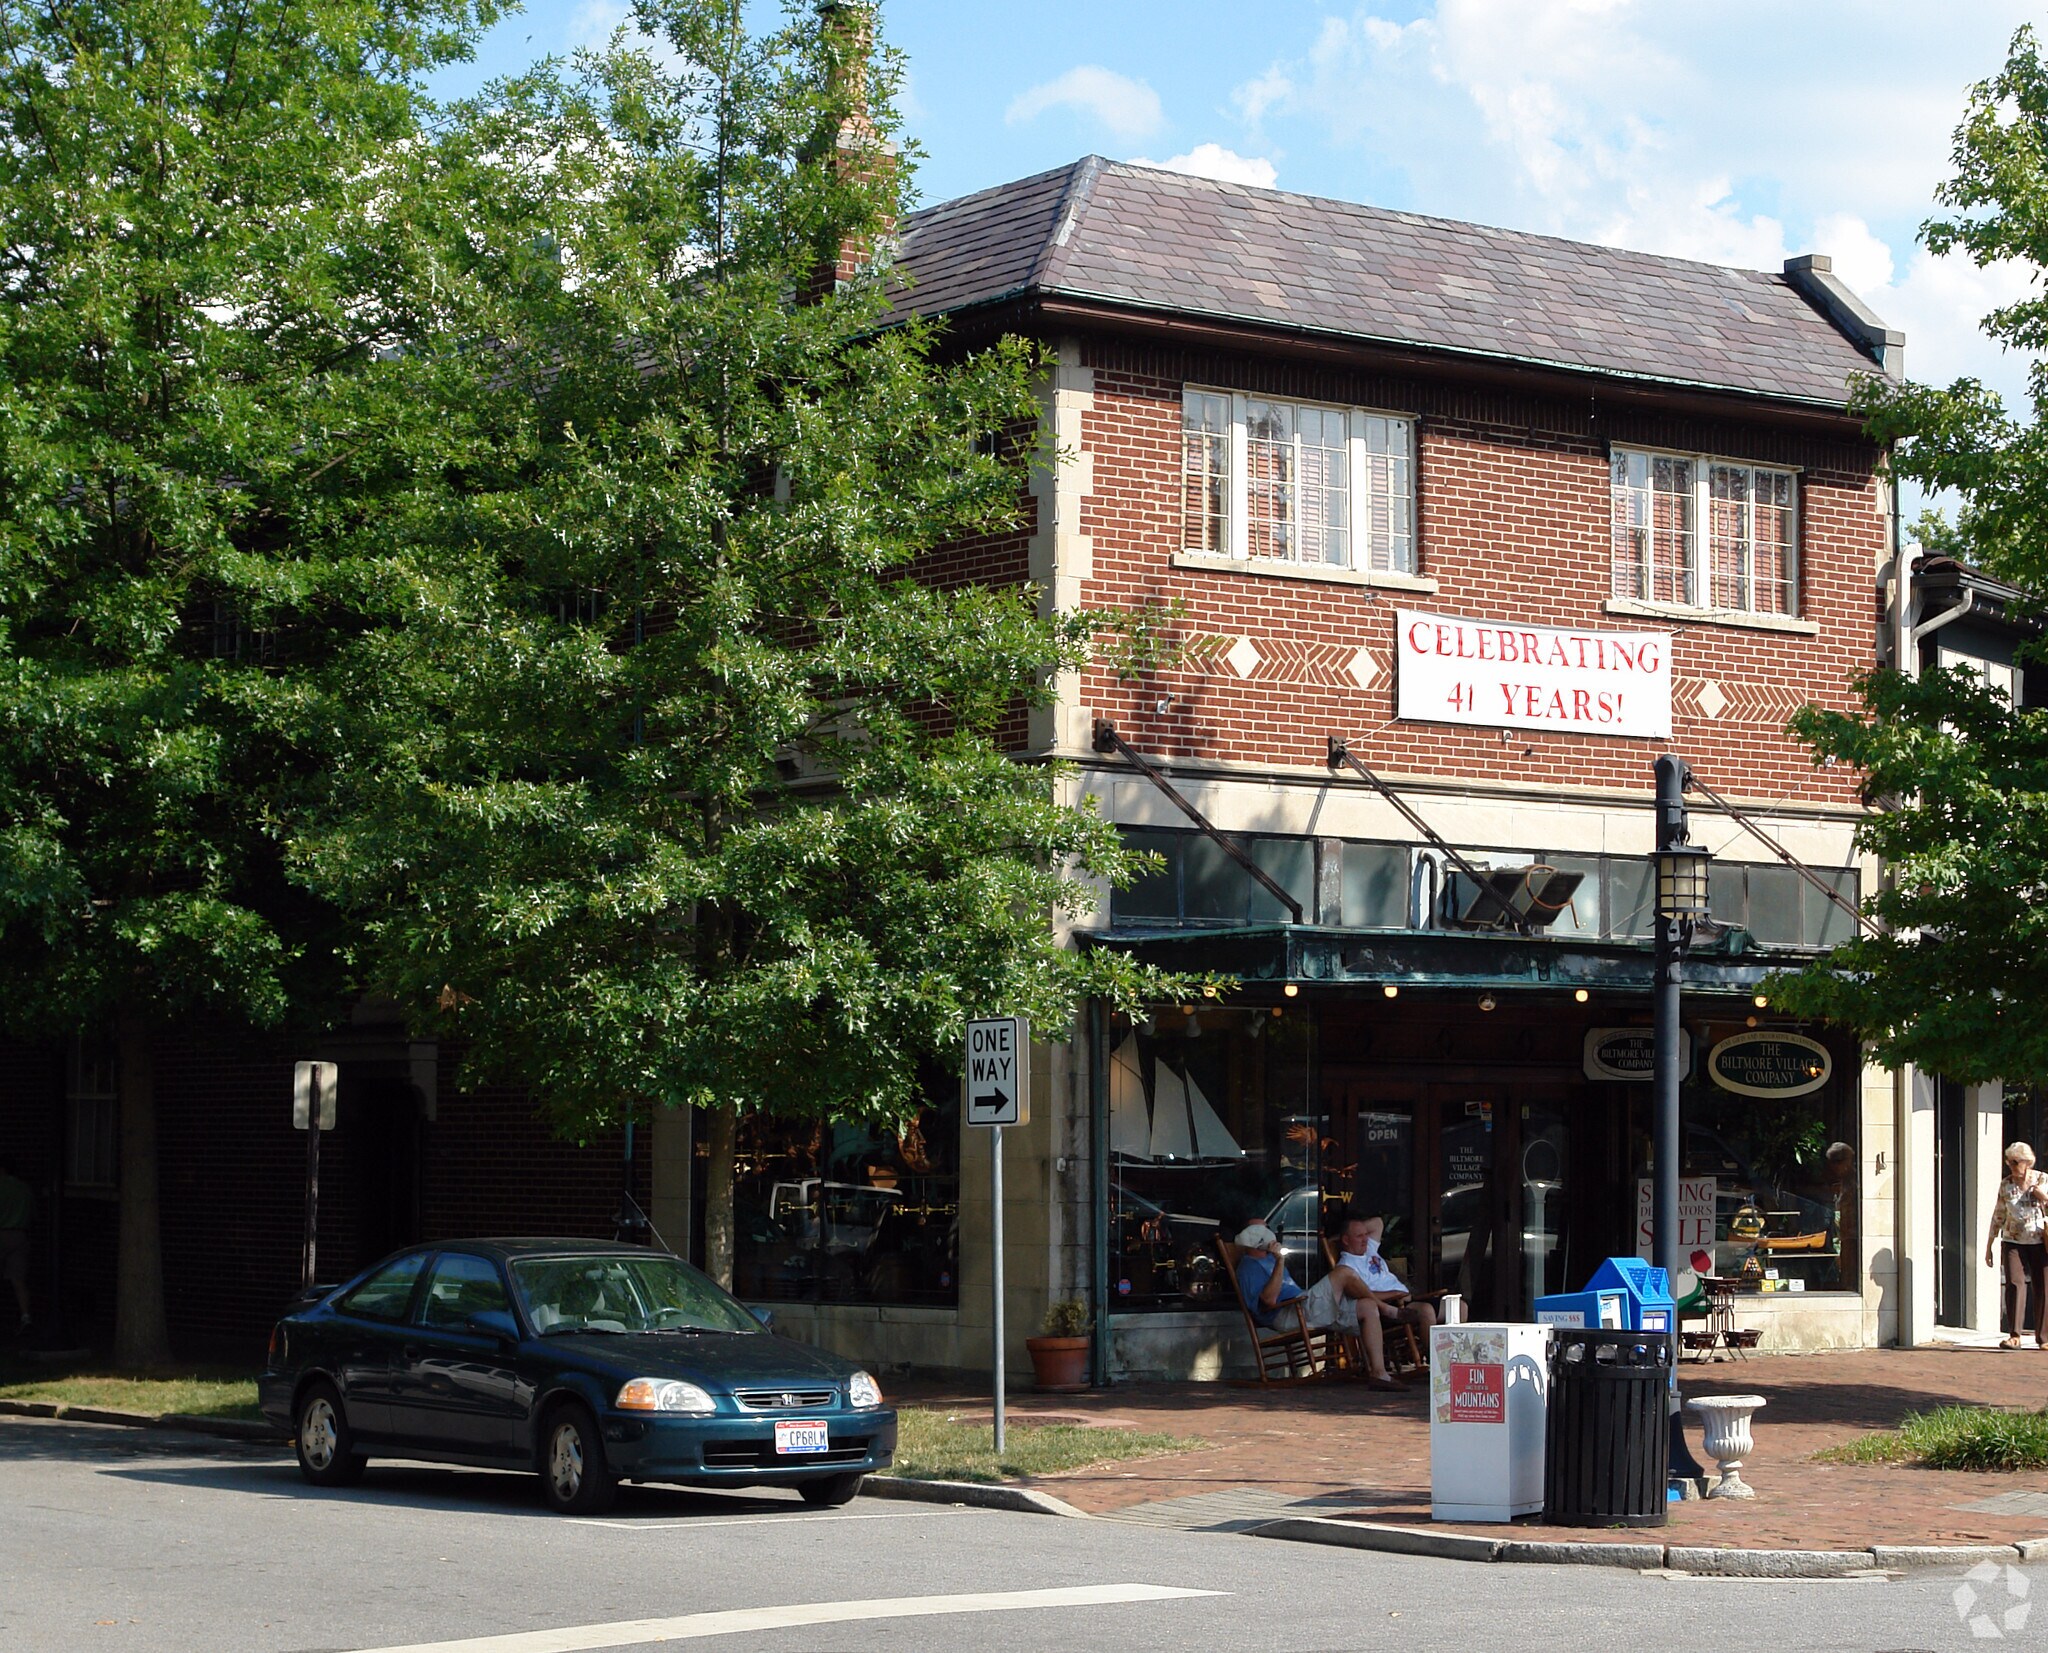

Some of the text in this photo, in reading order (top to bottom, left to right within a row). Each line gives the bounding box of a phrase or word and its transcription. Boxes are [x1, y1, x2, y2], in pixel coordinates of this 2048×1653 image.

[1408, 621, 1660, 674] CELEBRATING
[1447, 681, 1623, 724] 41 YEARS!
[973, 1028, 1010, 1053] ONE
[1629, 1039, 1645, 1049] THE
[1601, 1048, 1639, 1059] BILTMORE
[1760, 1043, 1781, 1056] THE
[972, 1057, 1011, 1082] WAY
[1721, 1056, 1819, 1071] BILTMORE VILLAGE
[1745, 1071, 1795, 1084] COMPANY
[1368, 1129, 1398, 1141] OPEN
[1449, 1172, 1483, 1180] COMPANY
[1639, 1218, 1711, 1247] SLE
[1543, 1313, 1568, 1322] SAVING
[1469, 1368, 1485, 1384] FUN
[1455, 1392, 1500, 1408] MOUNTAINS
